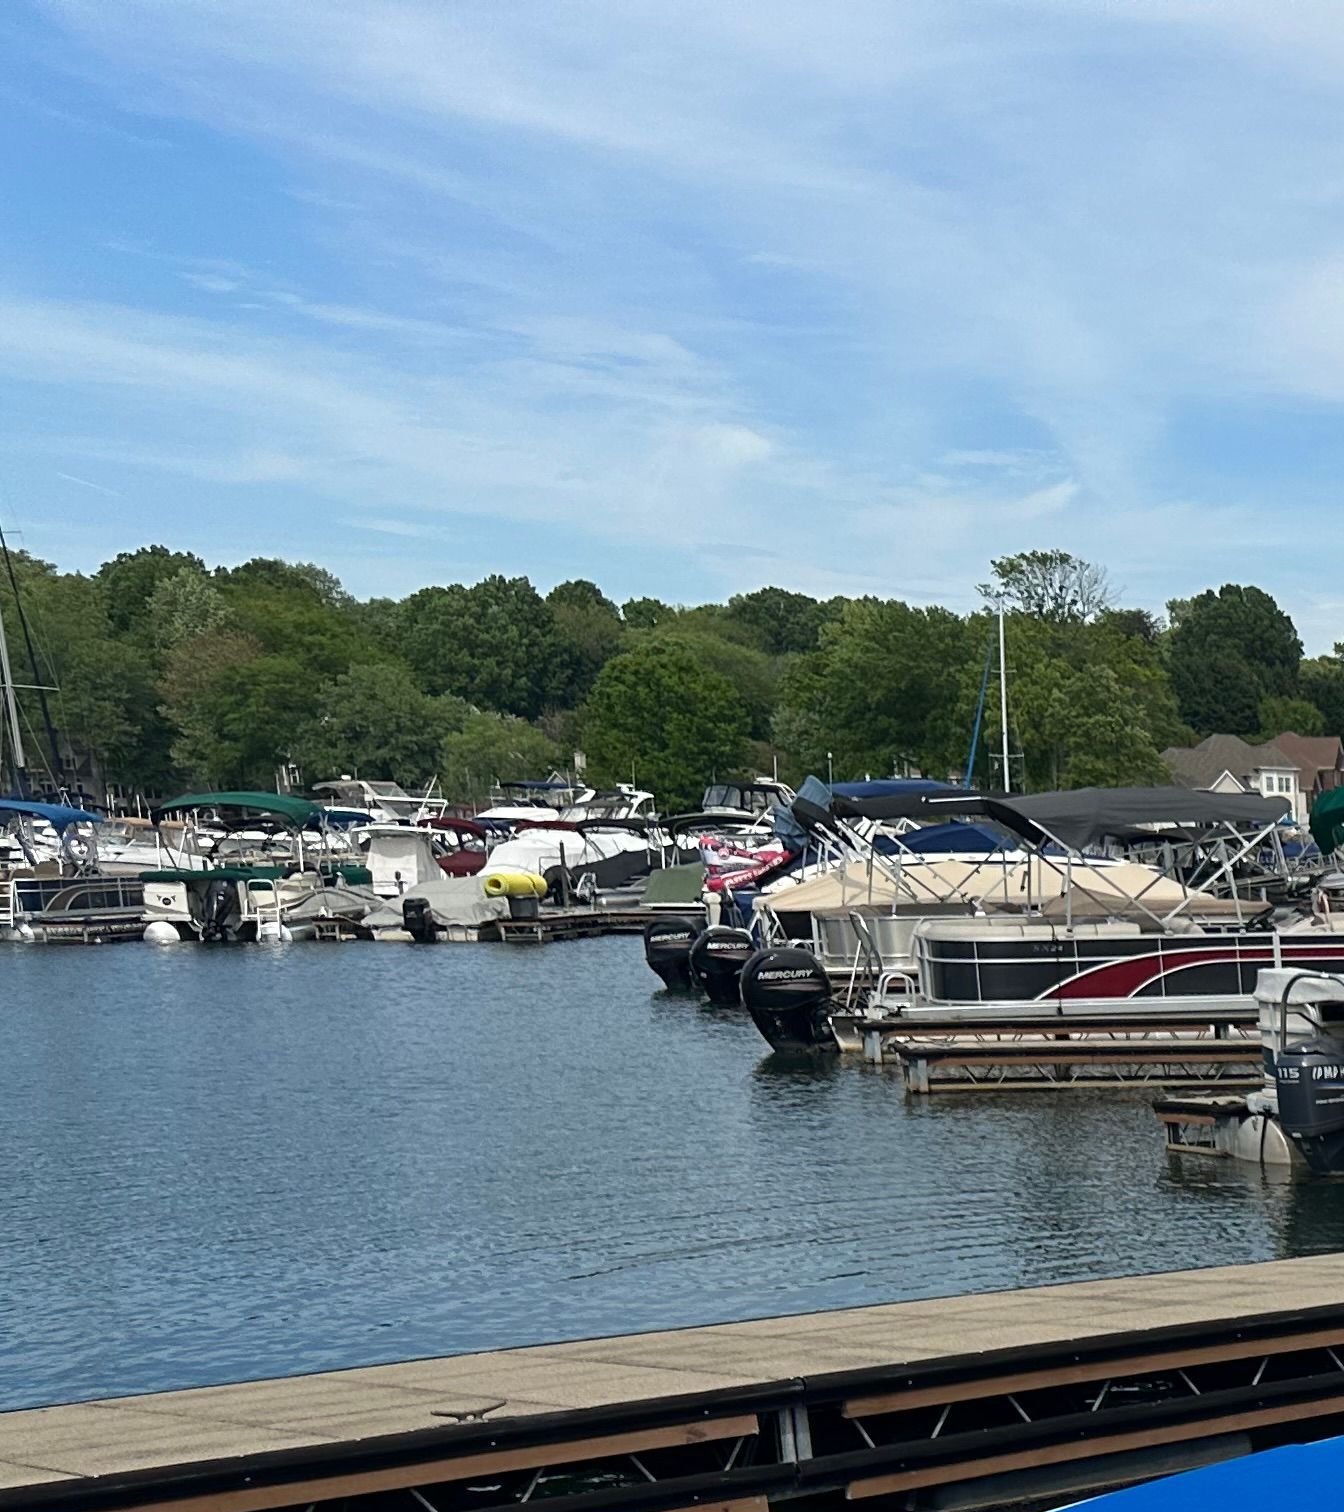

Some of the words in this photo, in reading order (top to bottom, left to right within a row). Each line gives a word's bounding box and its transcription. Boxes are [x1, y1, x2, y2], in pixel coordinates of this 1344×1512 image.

[650, 931, 691, 942] MERCURY
[707, 942, 750, 950] MERCURY
[757, 969, 813, 980] MERCURY
[1277, 1067, 1300, 1079] 115
